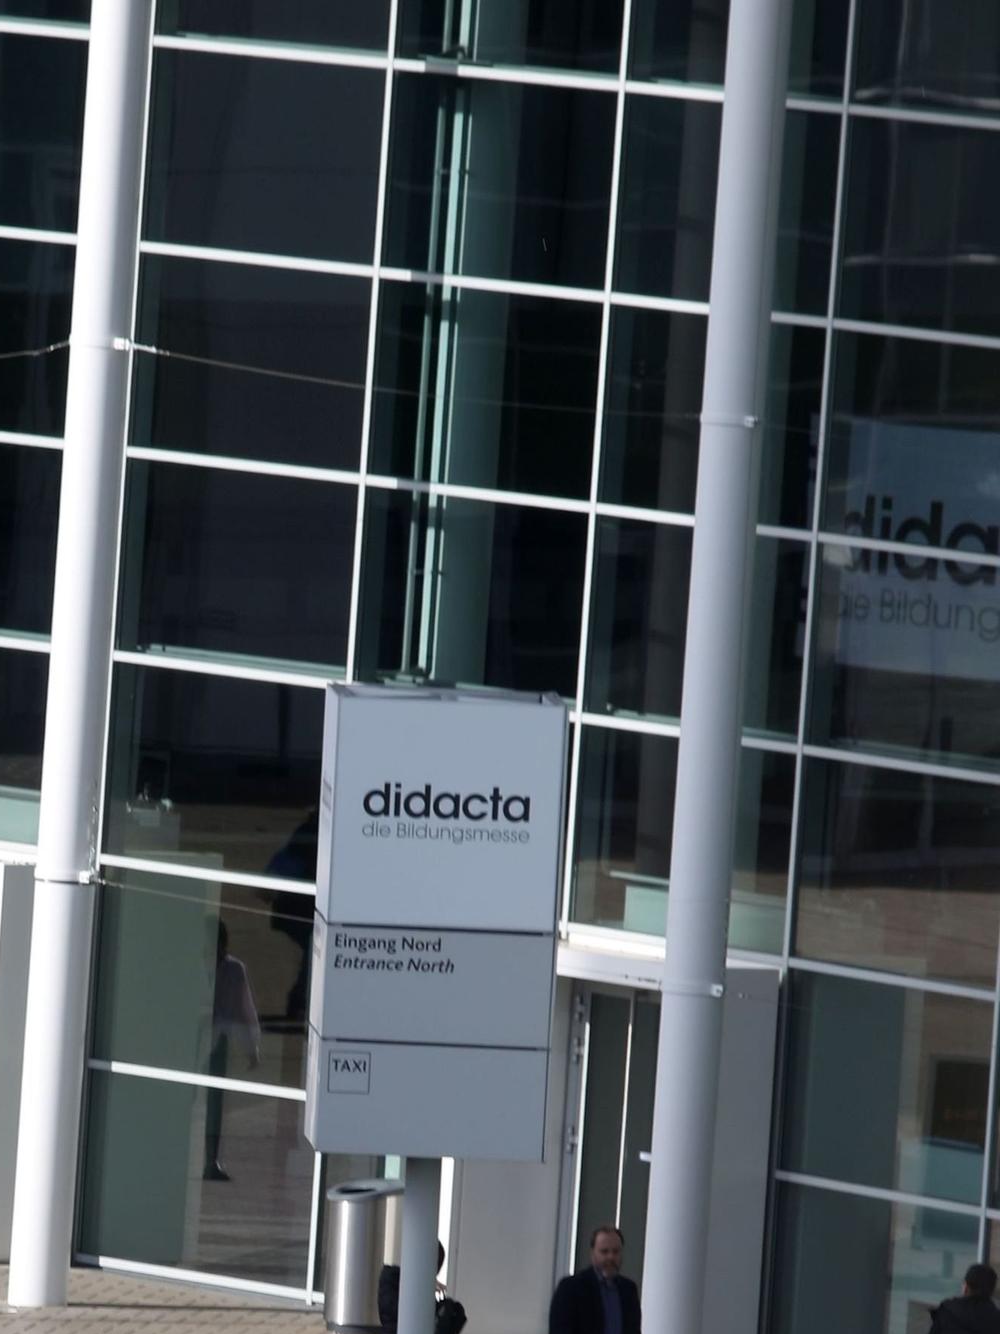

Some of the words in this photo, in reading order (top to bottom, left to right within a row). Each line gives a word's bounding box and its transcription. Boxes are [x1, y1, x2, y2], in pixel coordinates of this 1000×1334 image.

[362, 781, 531, 824] didacta
[361, 821, 392, 839] die
[396, 822, 531, 845] Bildungsmesse
[334, 932, 397, 955] Eingang
[401, 936, 442, 953] Nord
[334, 954, 404, 972] Entrance
[407, 957, 455, 974] North
[333, 1059, 367, 1073] TAXI
